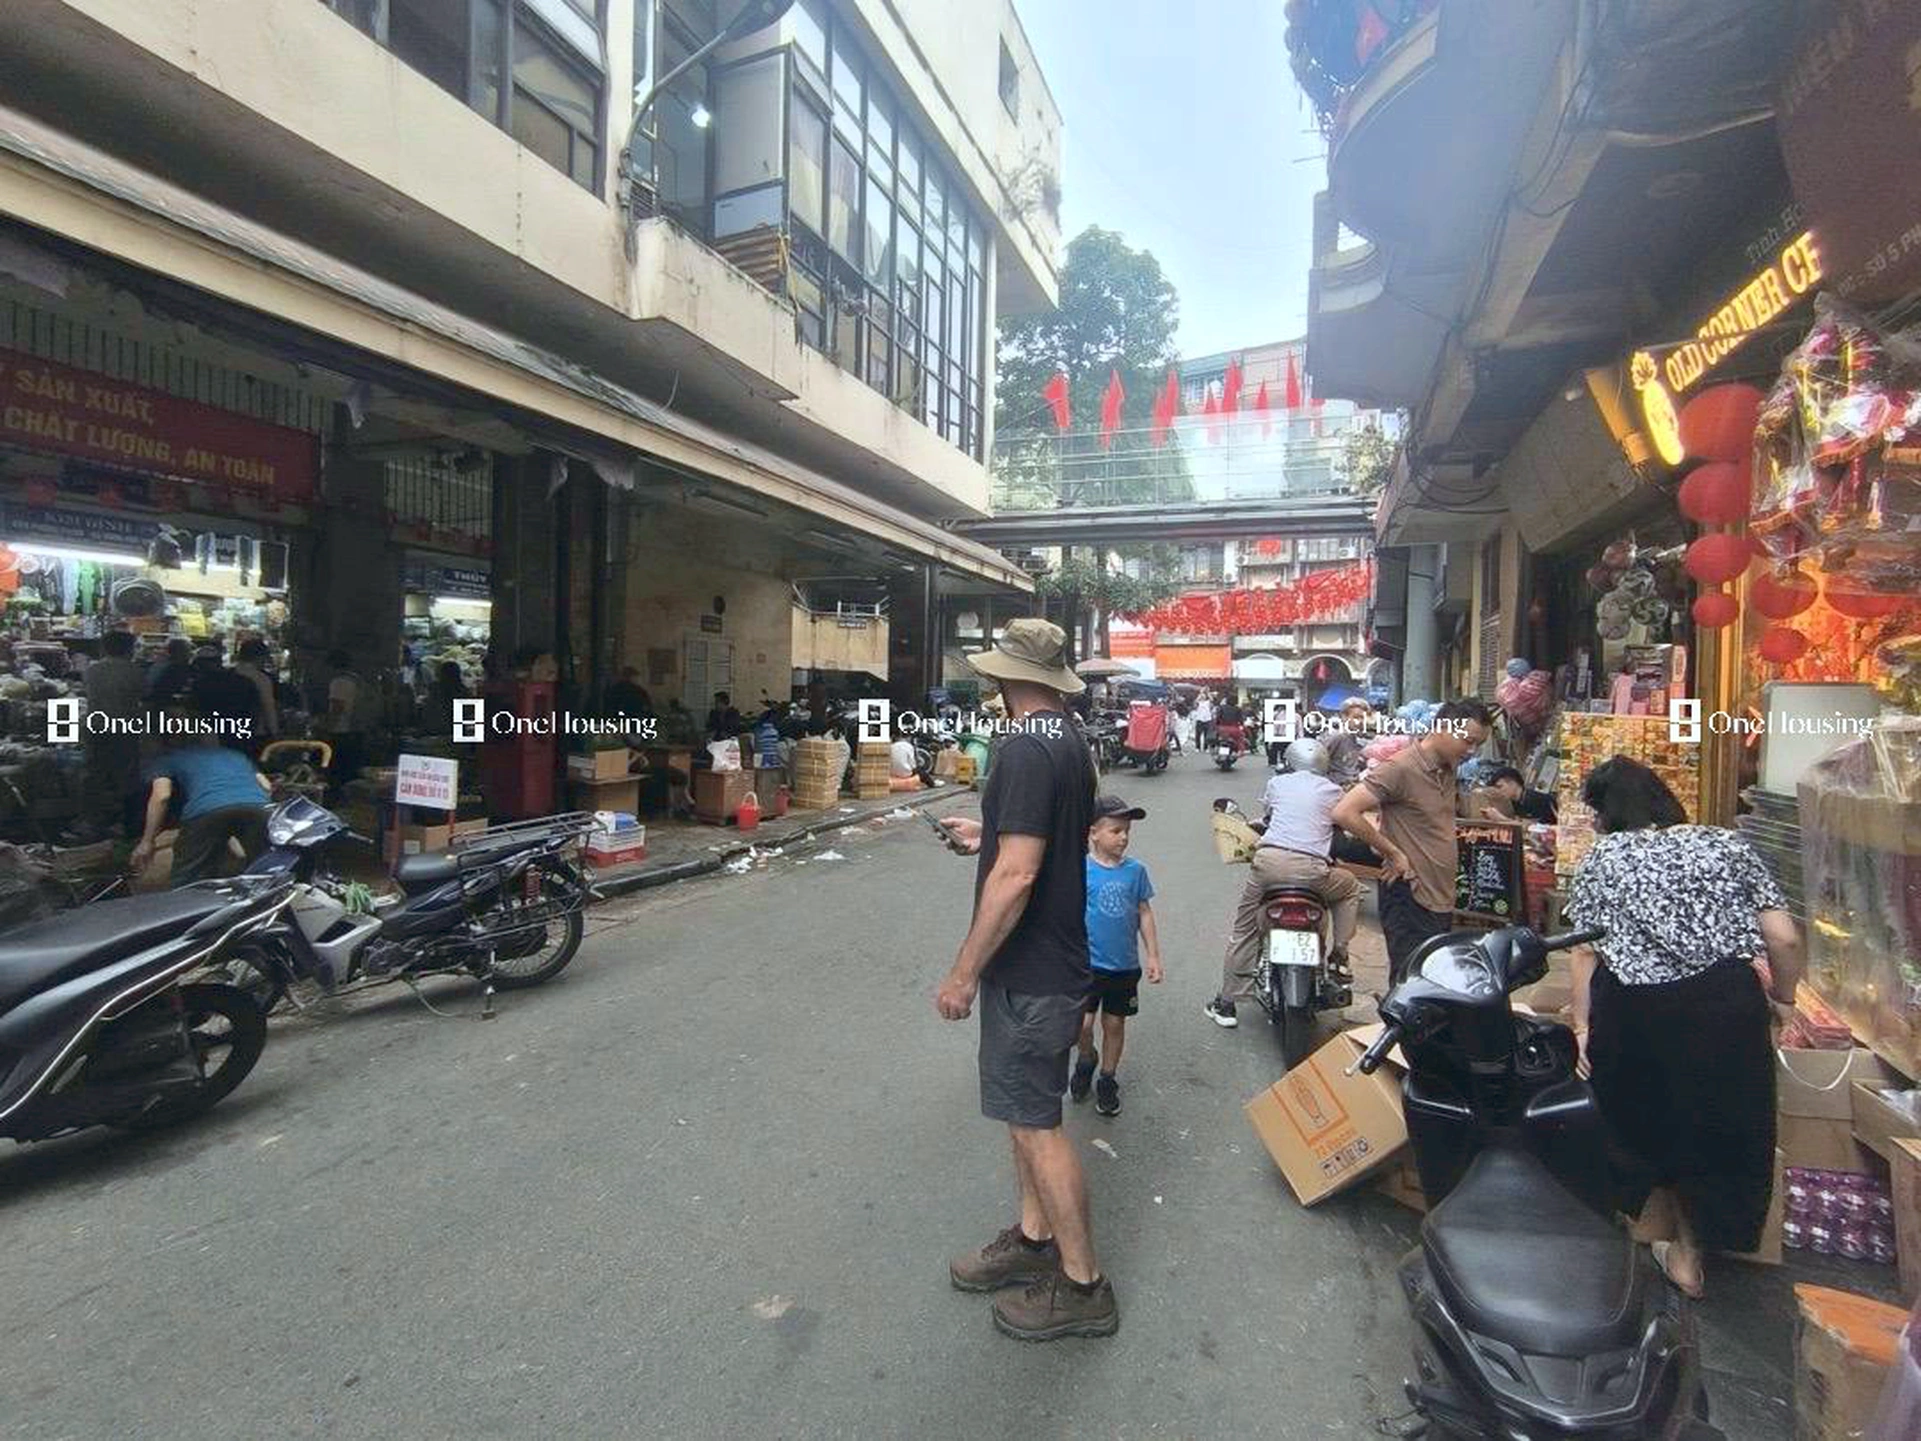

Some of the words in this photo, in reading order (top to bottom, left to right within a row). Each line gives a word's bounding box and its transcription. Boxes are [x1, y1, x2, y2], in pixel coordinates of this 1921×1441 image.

[1665, 342, 1704, 393] OLD
[1697, 267, 1791, 367] CORNER
[184, 447, 216, 474] AN
